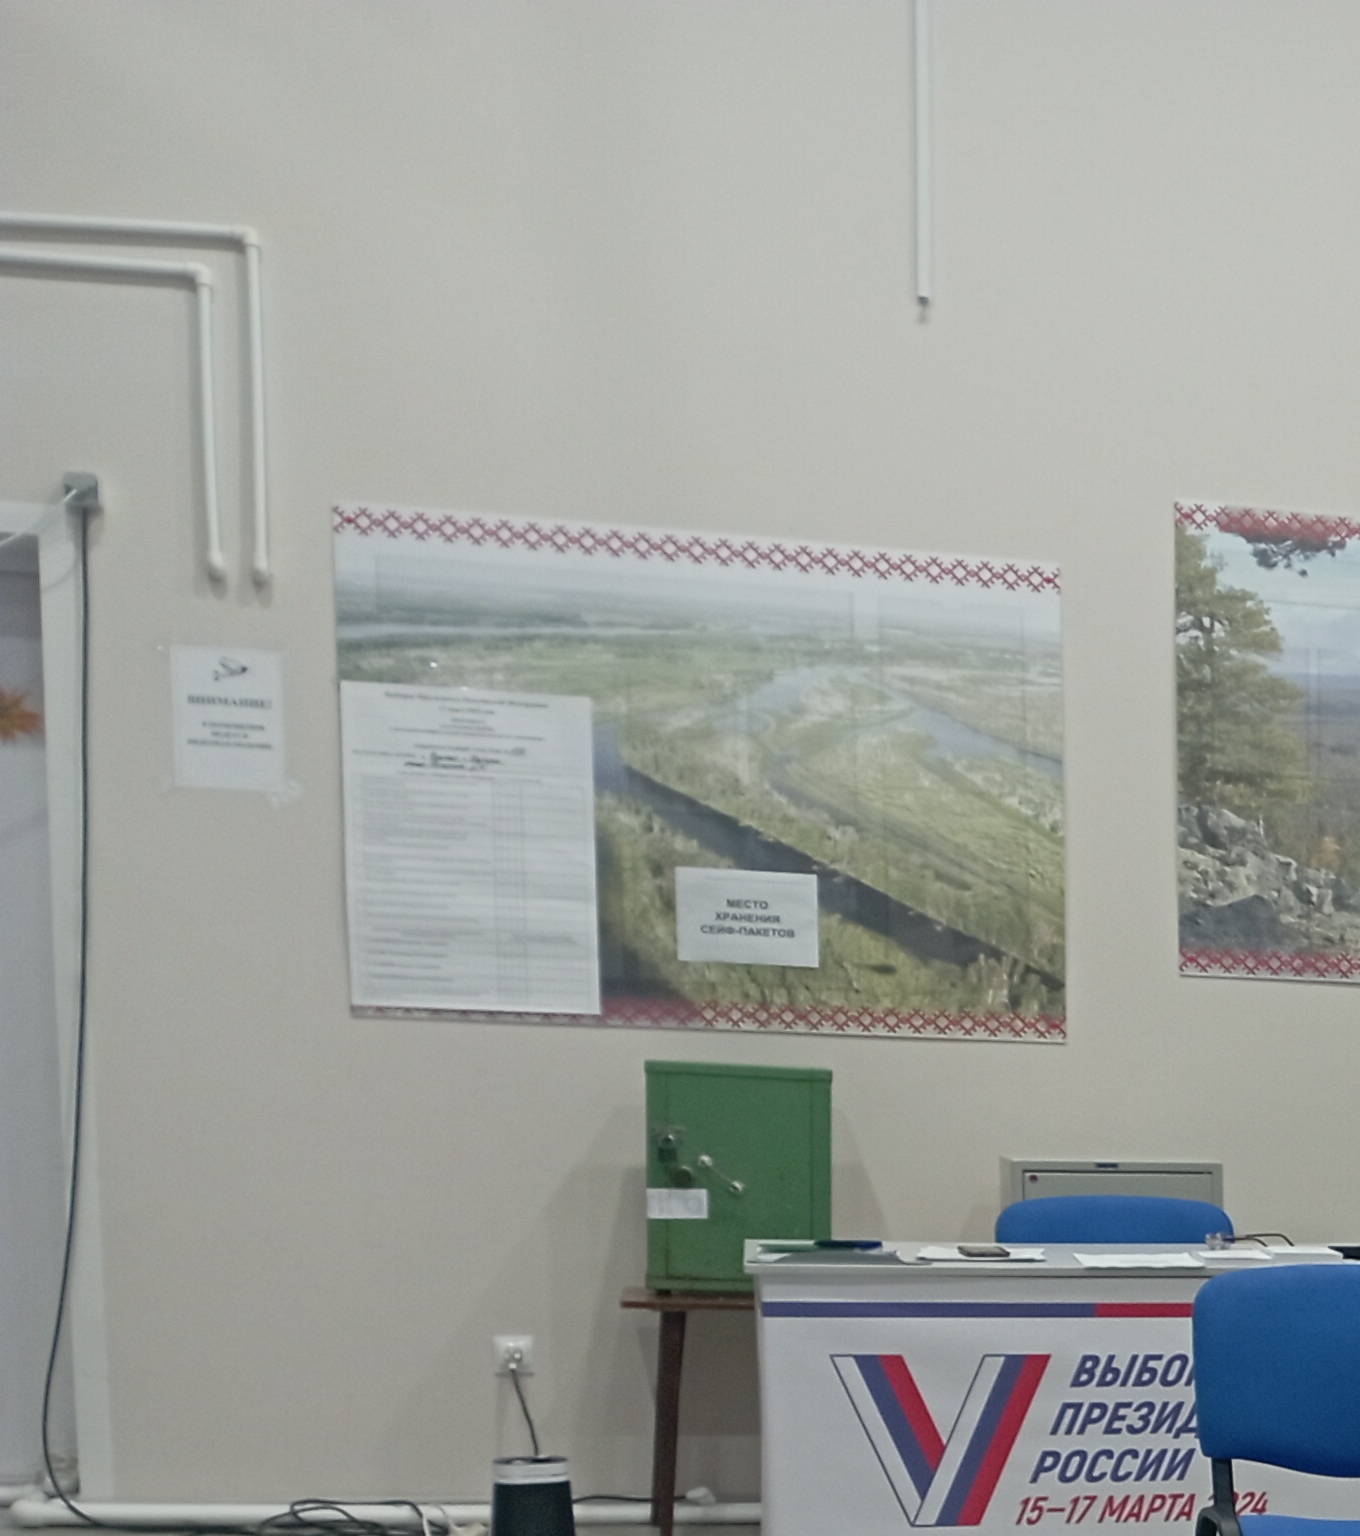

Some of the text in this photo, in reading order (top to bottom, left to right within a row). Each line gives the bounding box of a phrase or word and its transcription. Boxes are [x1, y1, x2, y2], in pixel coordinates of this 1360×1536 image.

[726, 899, 769, 910] МЕСТО
[715, 912, 781, 923] ХРАНЕНИЯ
[700, 925, 796, 938] СЕЙФ-ПАКЕТОВ
[1070, 1354, 1195, 1388] ВЫБО
[1029, 1448, 1196, 1484] РОССИИ
[1097, 1493, 1196, 1524] МАРТА
